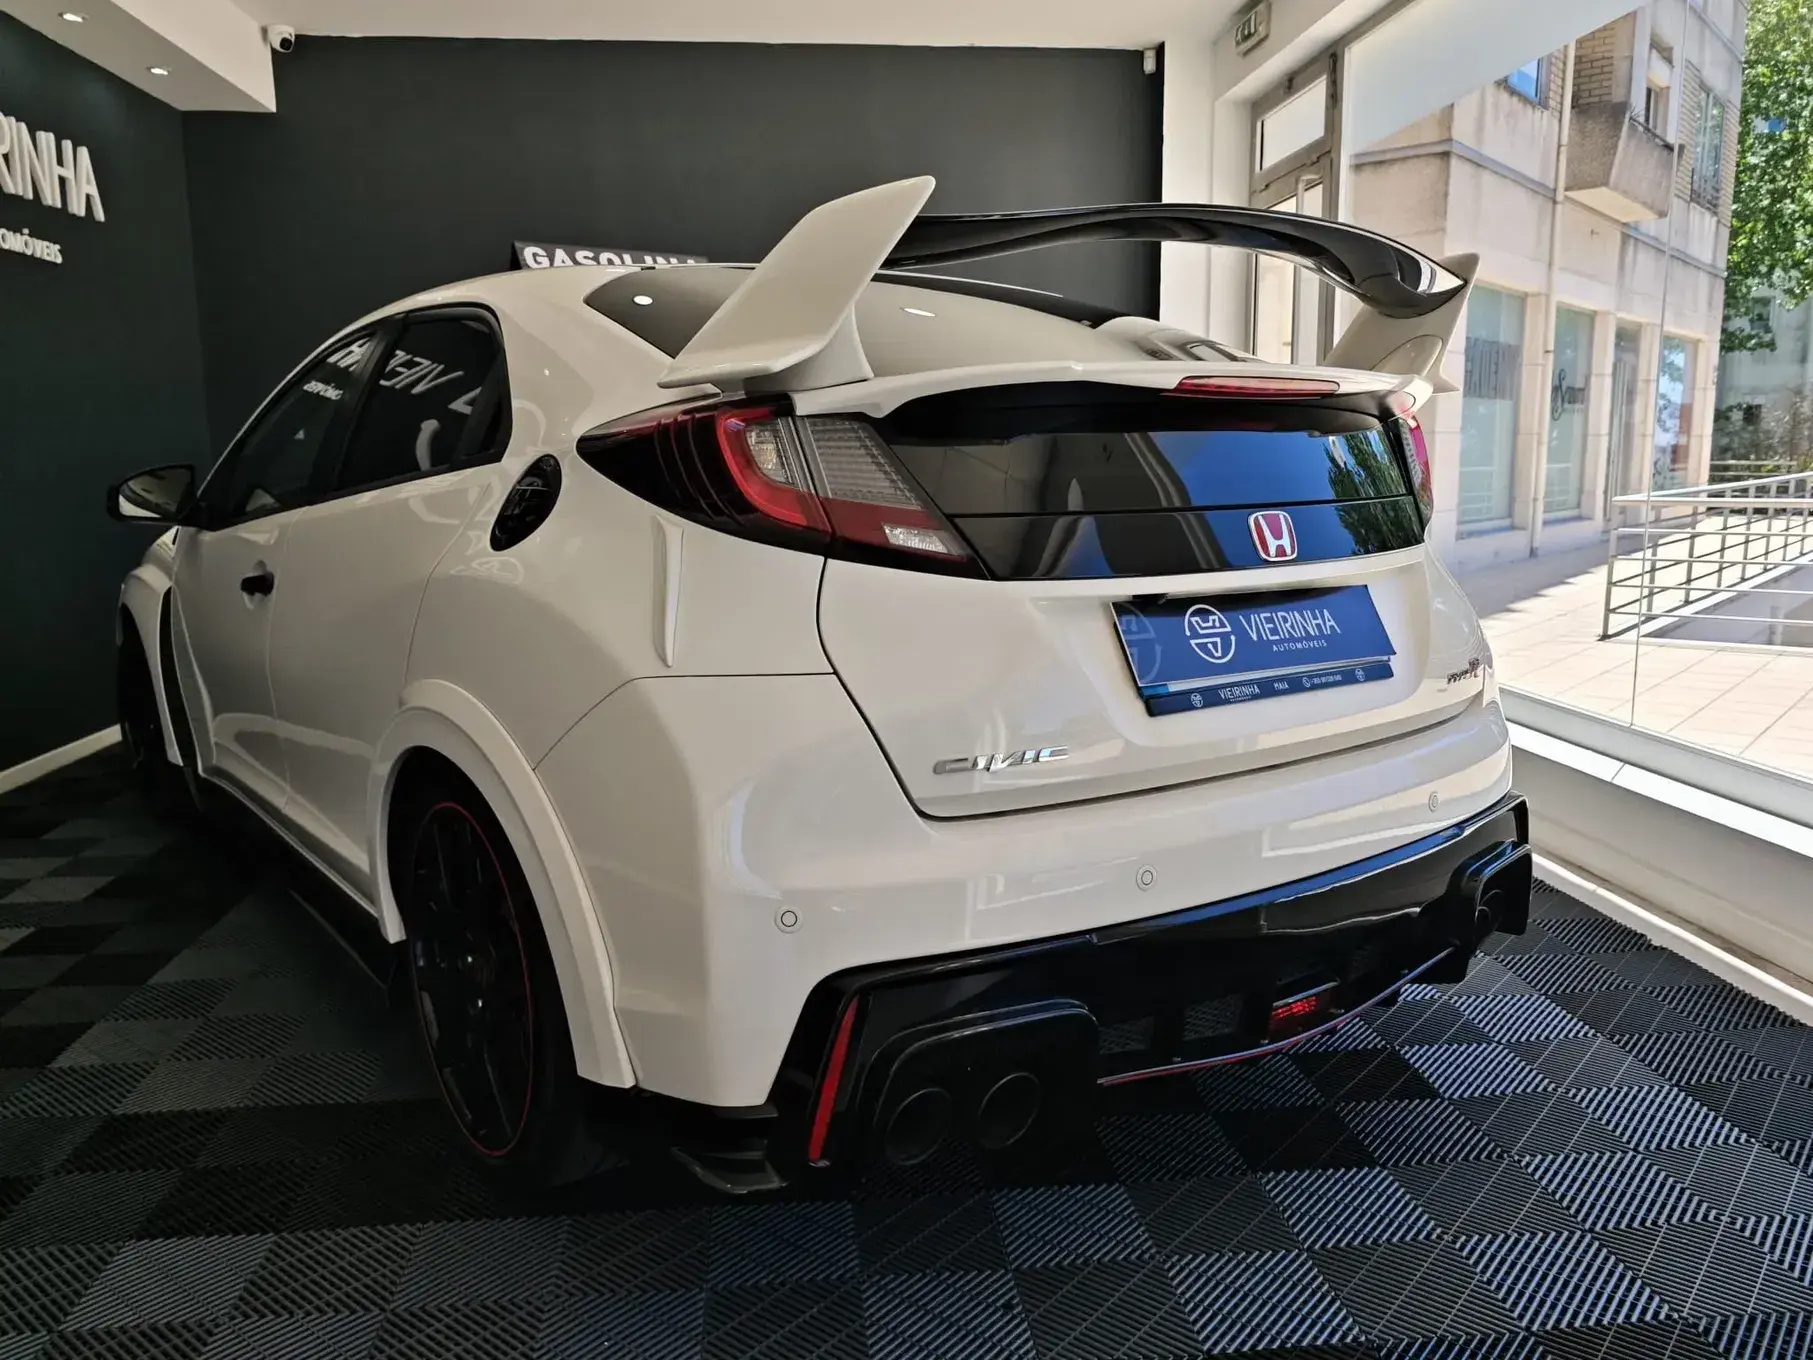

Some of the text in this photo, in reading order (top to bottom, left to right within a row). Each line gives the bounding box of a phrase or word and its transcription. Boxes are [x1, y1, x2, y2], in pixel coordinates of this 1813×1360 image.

[523, 246, 697, 269] GASO
[1239, 608, 1341, 641] VIEIRINHA
[1272, 639, 1327, 652] AUTOMÓVEIS
[1218, 684, 1260, 699] VIEIRINHA
[933, 745, 1069, 774] CIVIC
